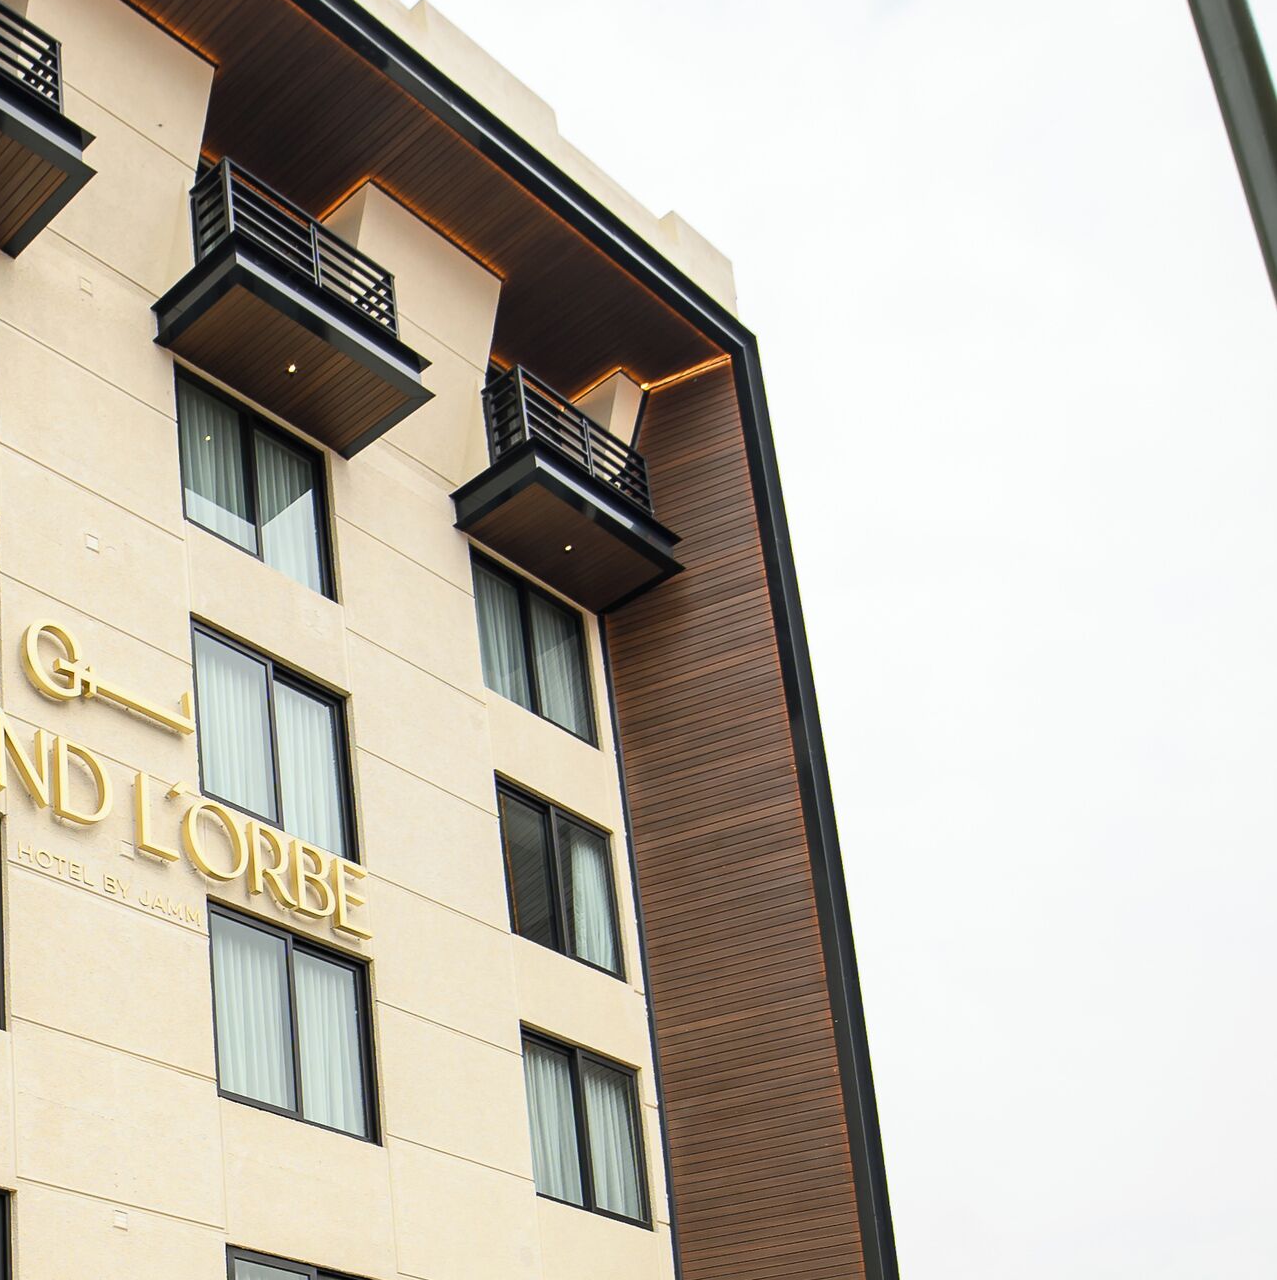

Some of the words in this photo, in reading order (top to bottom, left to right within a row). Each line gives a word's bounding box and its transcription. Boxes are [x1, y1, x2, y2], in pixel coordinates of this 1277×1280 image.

[17, 840, 94, 887] HOTEL
[102, 873, 130, 899] BY
[138, 889, 201, 927] JAMM
